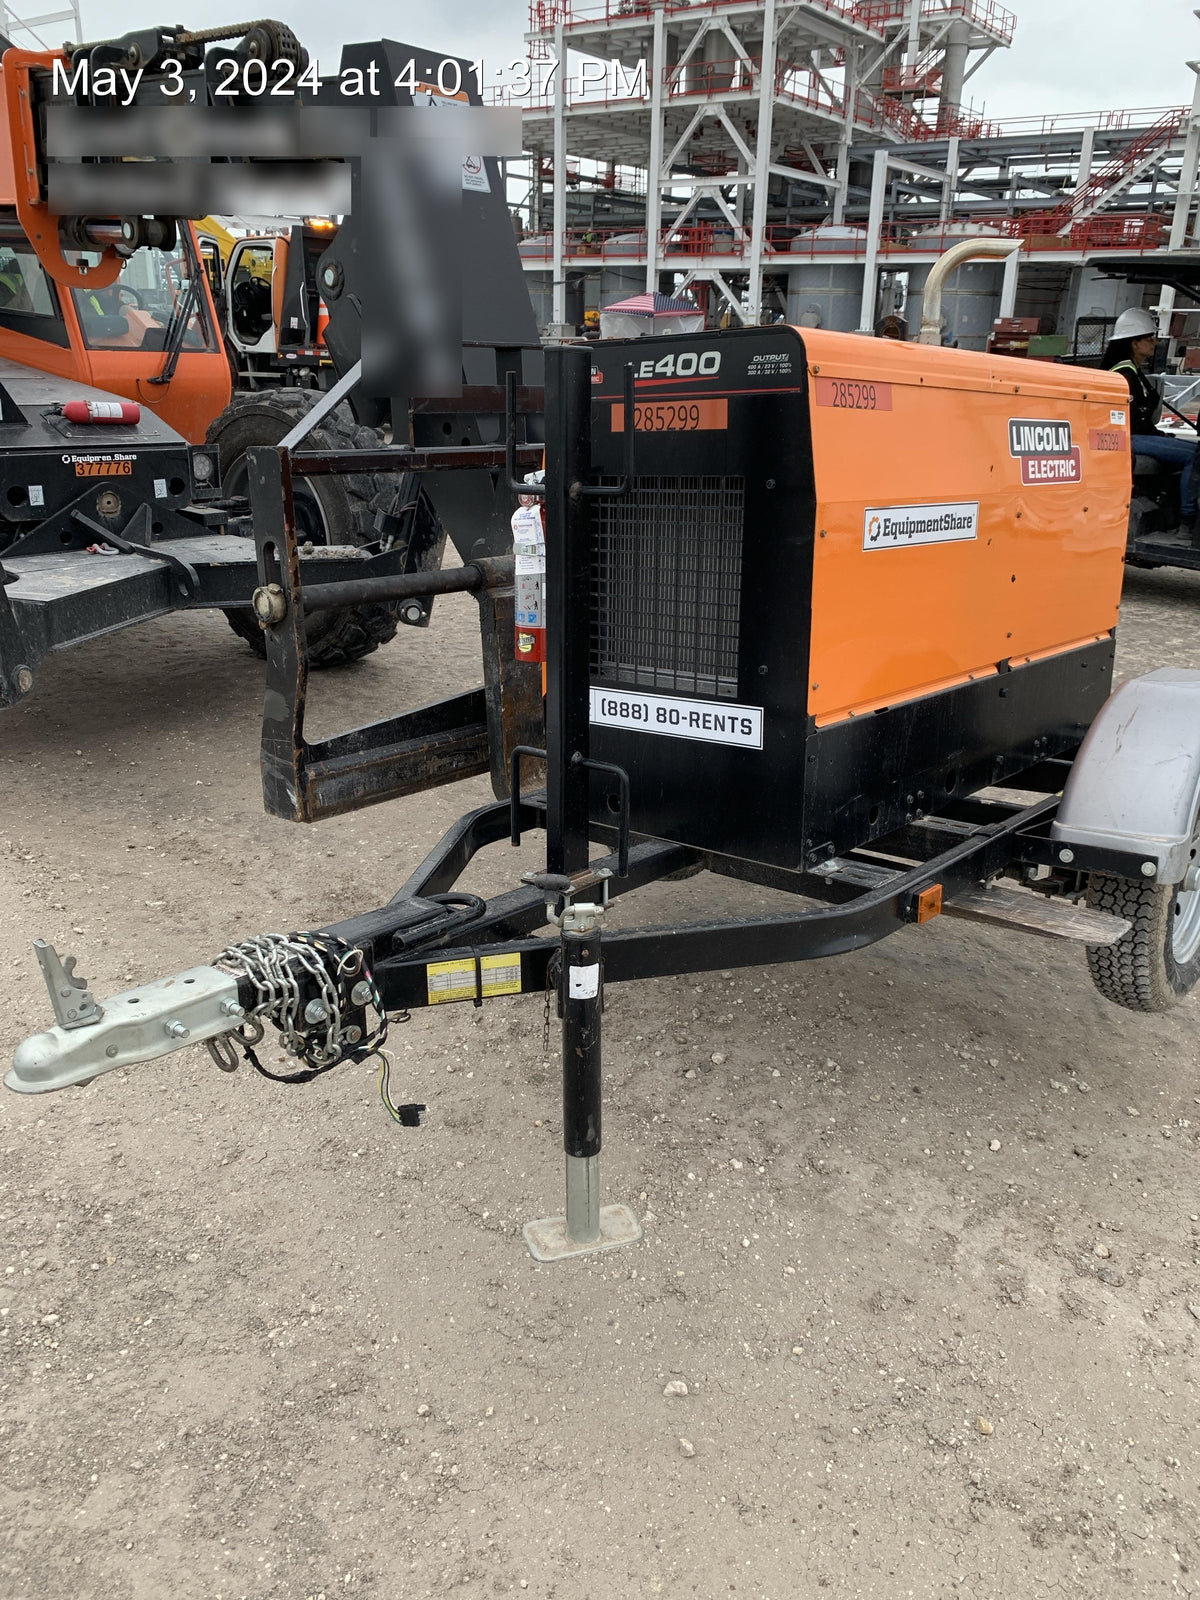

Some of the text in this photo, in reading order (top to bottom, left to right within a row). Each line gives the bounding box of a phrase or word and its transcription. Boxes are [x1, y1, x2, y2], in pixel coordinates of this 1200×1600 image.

[753, 353, 787, 362] OUTPUT
[832, 381, 876, 410] 285299
[634, 404, 700, 431] 285299
[1012, 425, 1069, 452] LINCOLN
[76, 461, 131, 476] 377776
[1028, 459, 1076, 479] ELECTRIC
[882, 511, 973, 540] EquipmentShare
[601, 698, 753, 736] (888) 80-RENTS
